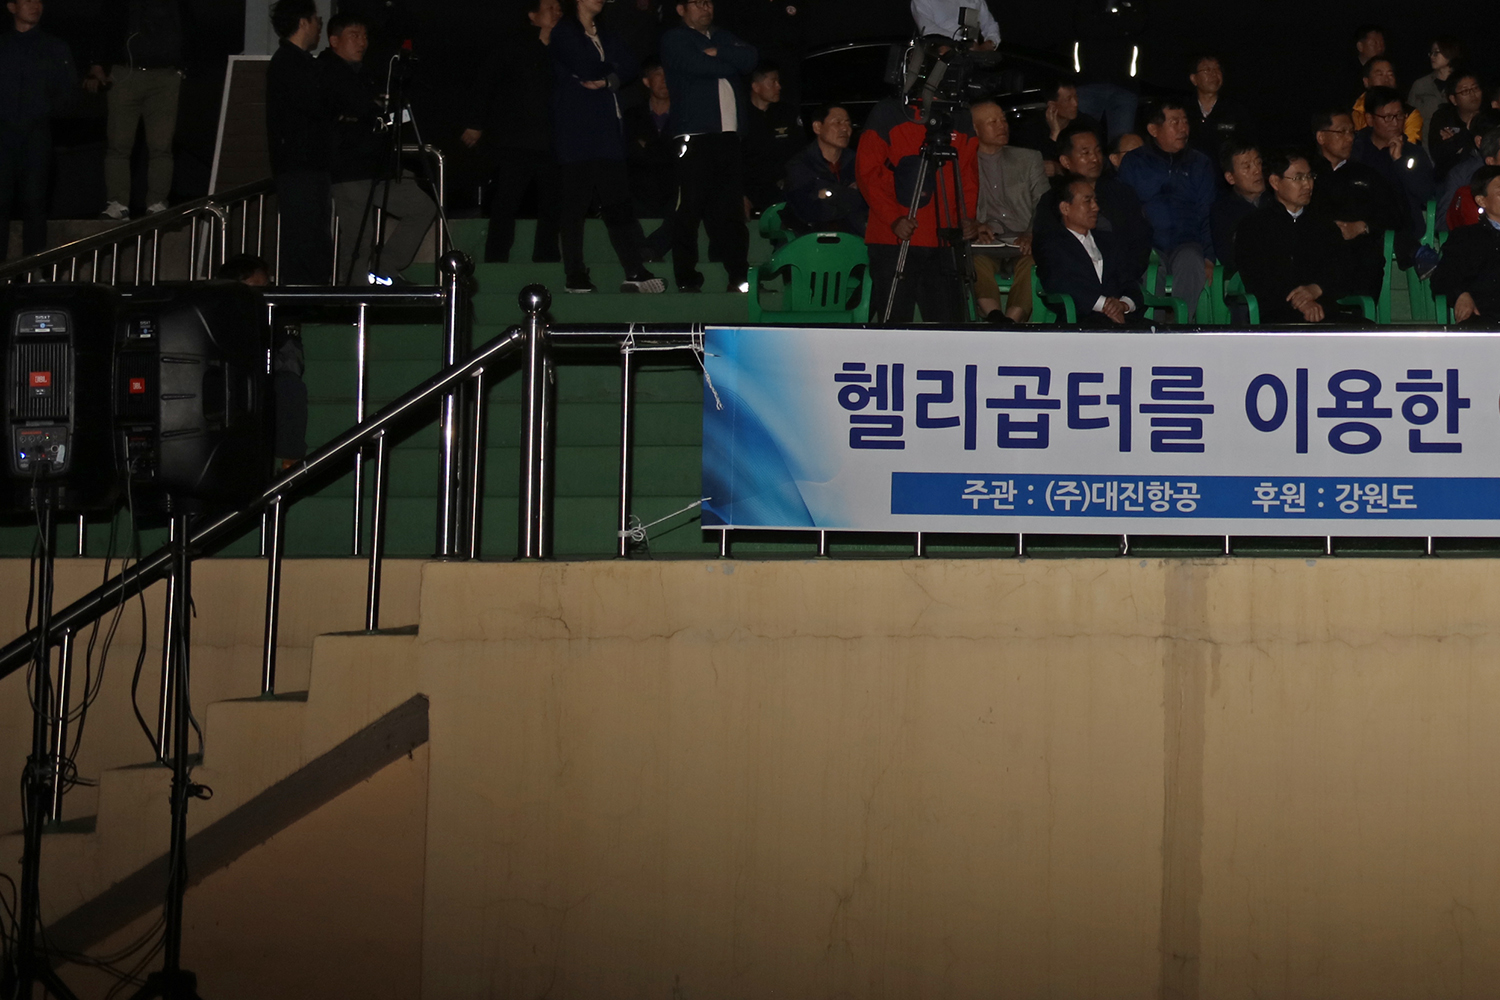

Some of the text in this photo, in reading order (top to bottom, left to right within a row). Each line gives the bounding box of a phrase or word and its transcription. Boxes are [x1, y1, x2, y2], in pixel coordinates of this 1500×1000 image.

[834, 361, 1215, 453] 헬리곱터를
[1245, 367, 1471, 455] 이용한
[1335, 483, 1418, 514] 강원도
